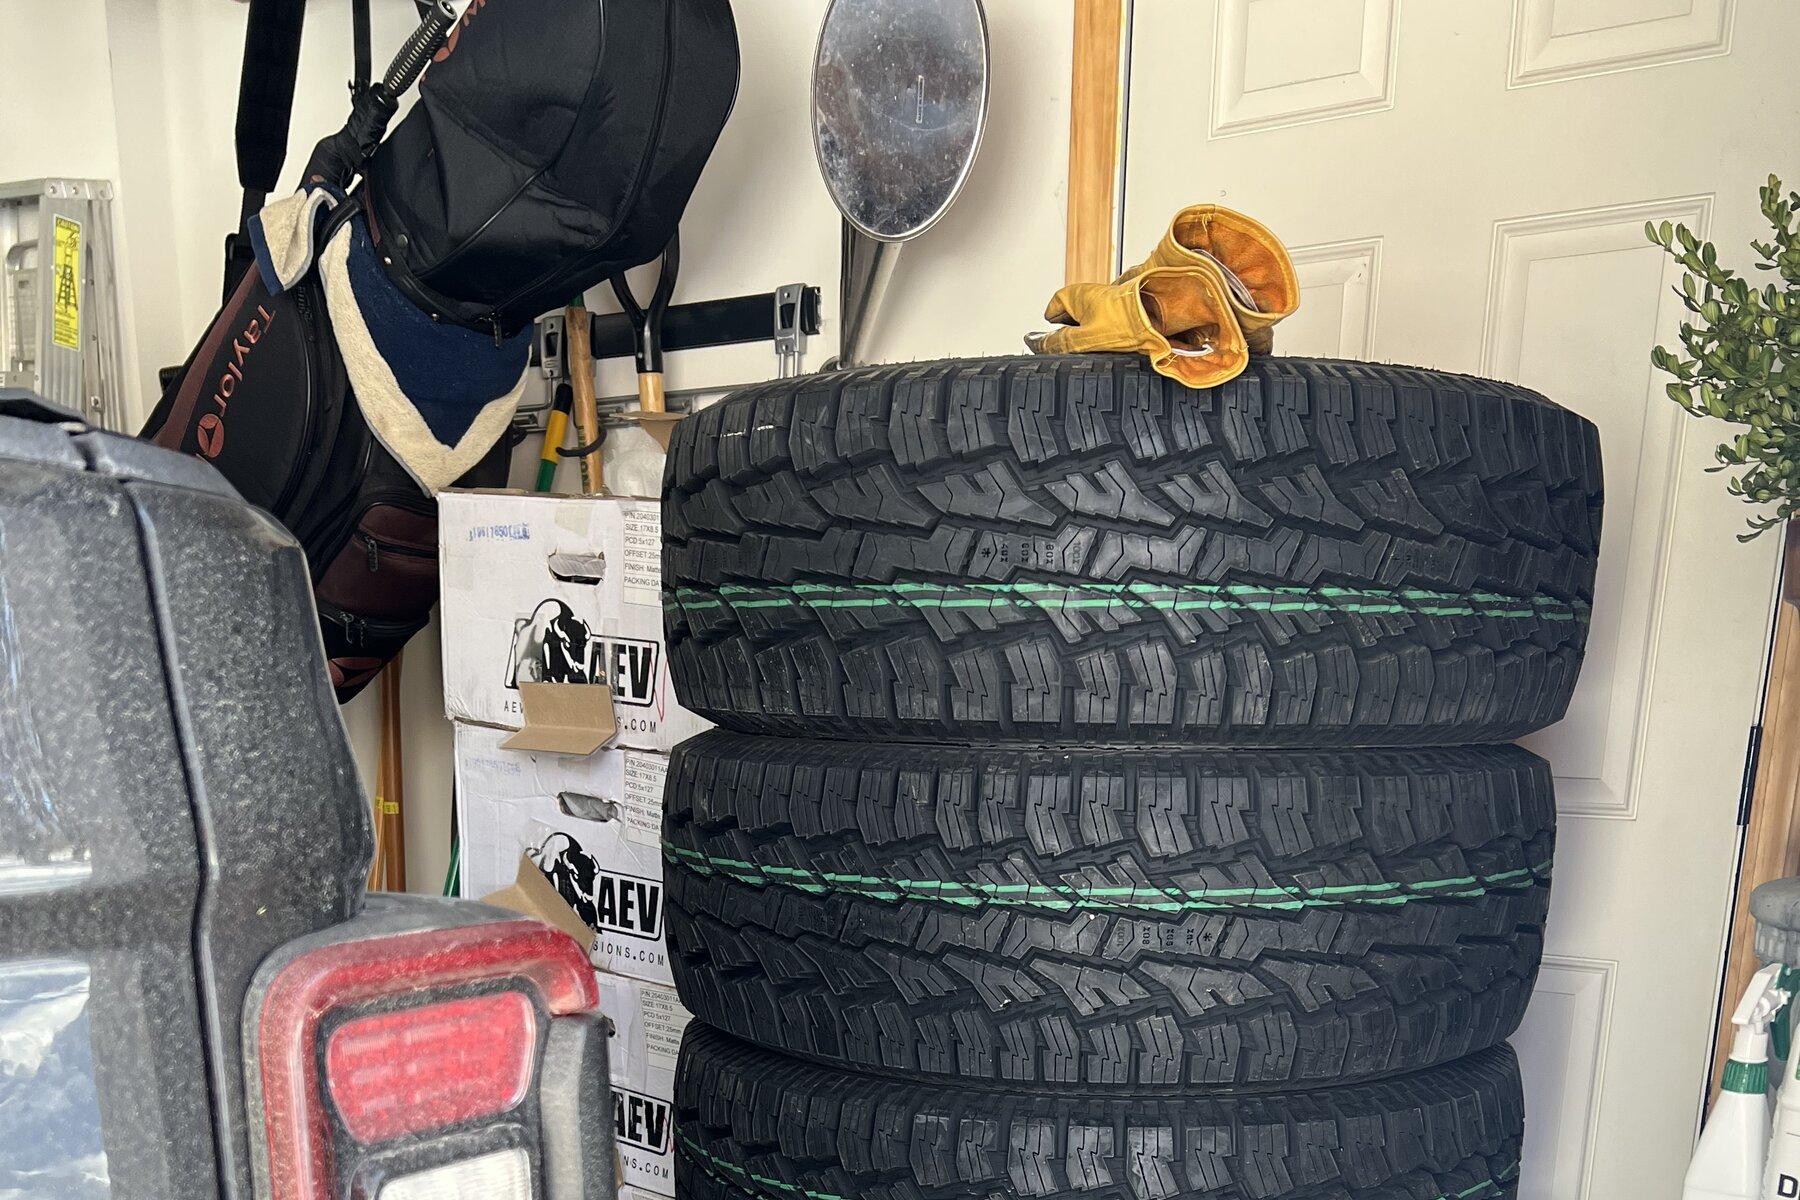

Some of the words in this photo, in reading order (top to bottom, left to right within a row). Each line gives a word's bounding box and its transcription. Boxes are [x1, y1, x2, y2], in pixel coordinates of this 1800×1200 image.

[211, 303, 277, 419] Taylor
[590, 641, 652, 699] AEV
[598, 876, 660, 934] AEV
[610, 1090, 666, 1149] AEV
